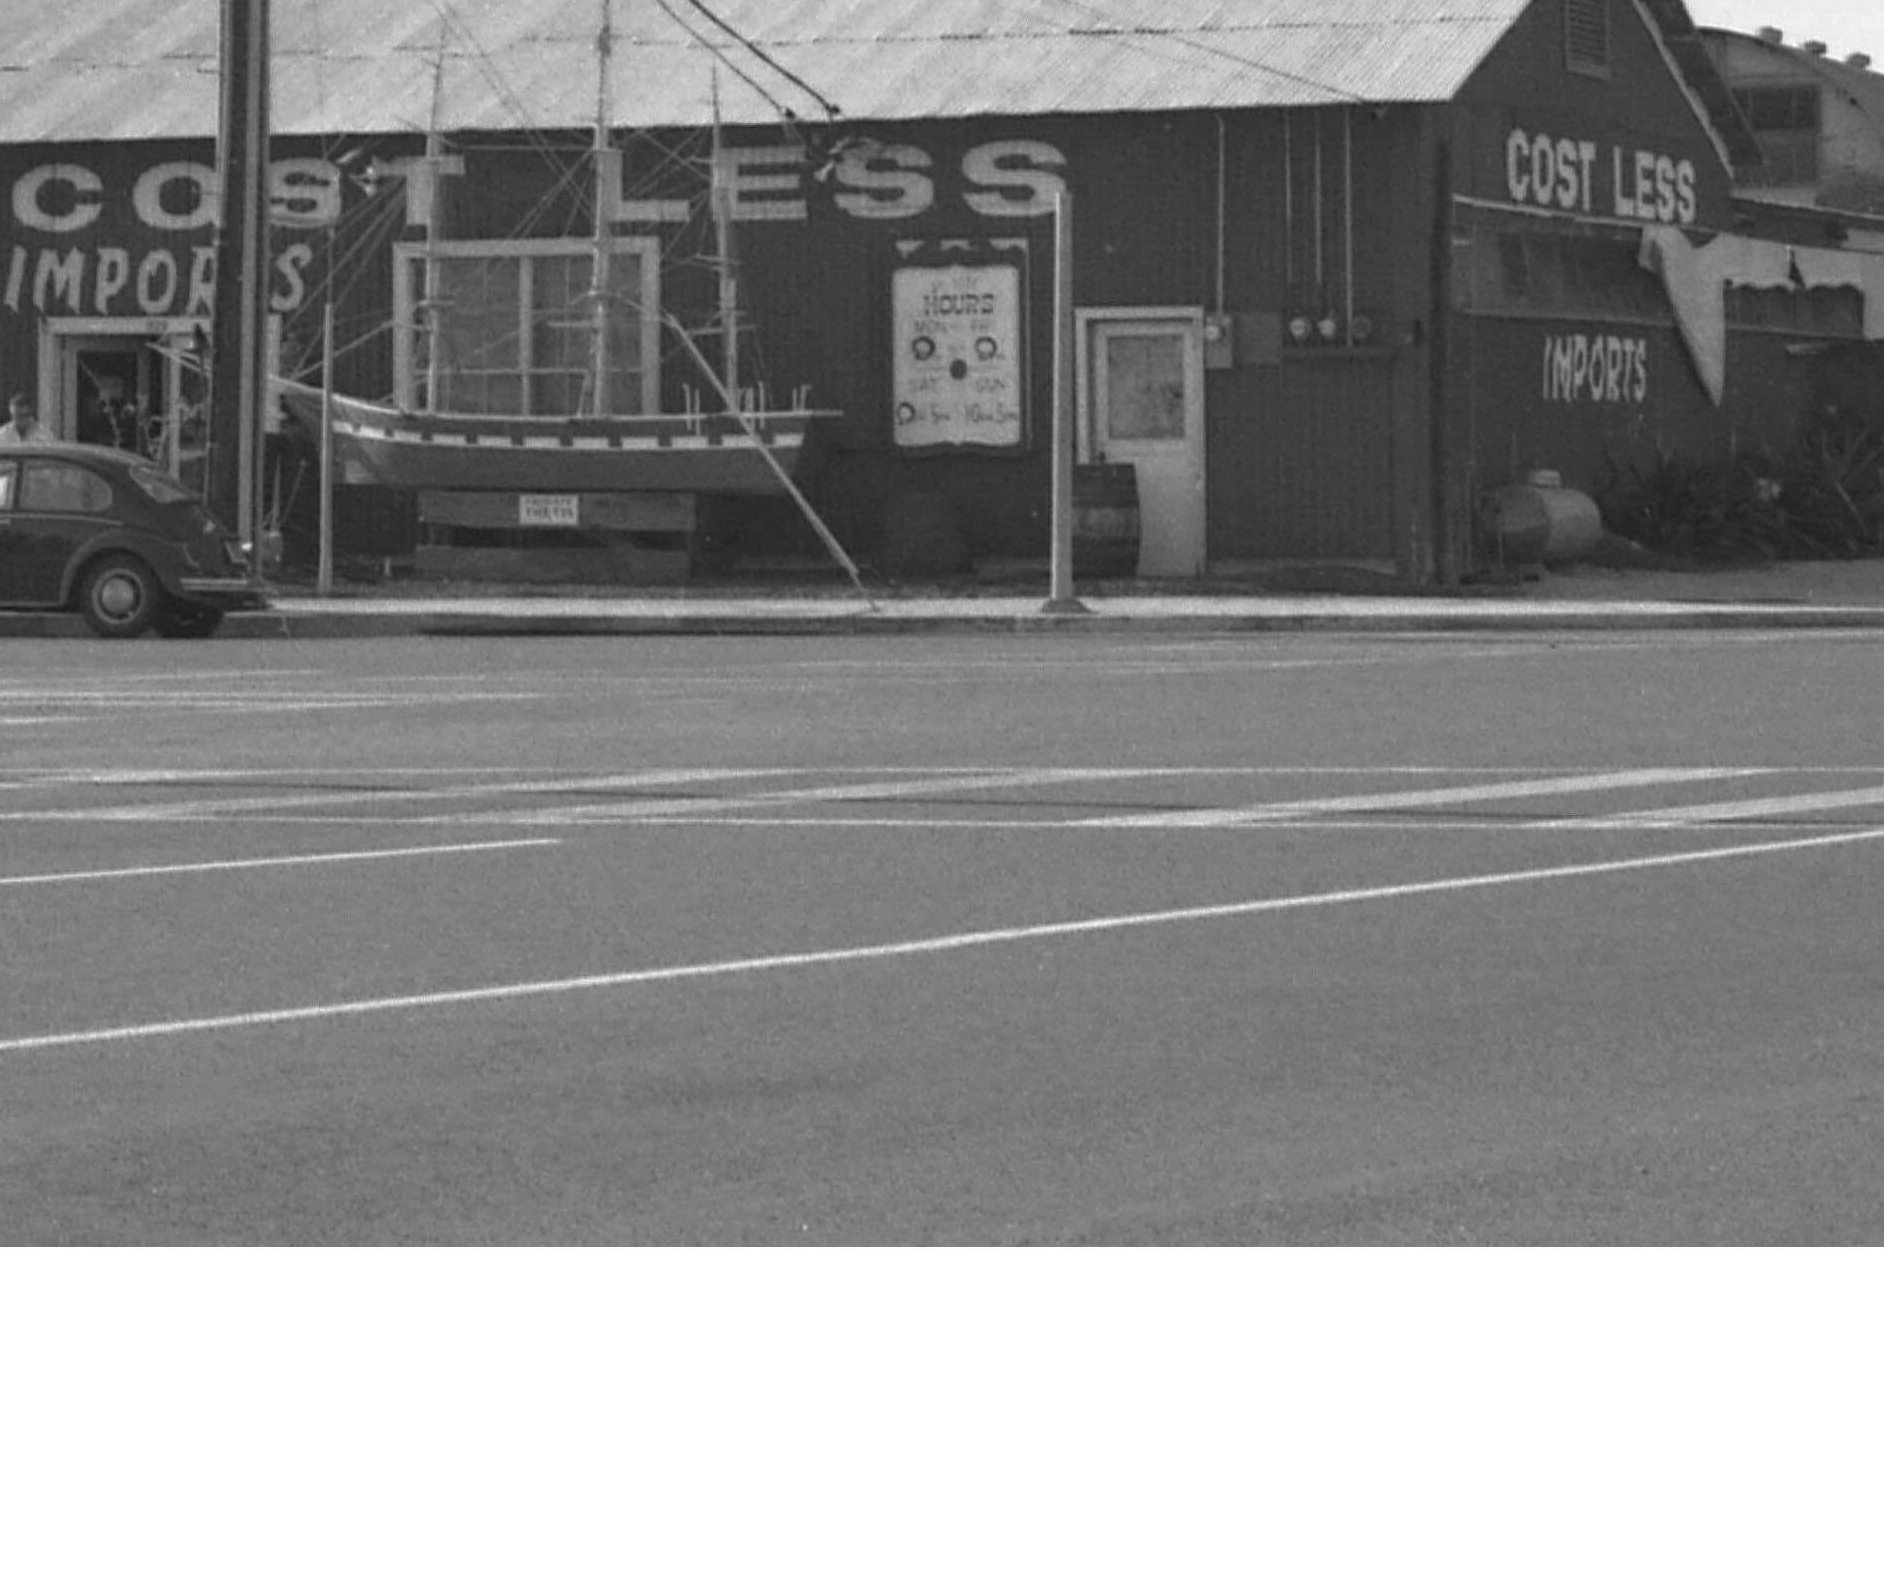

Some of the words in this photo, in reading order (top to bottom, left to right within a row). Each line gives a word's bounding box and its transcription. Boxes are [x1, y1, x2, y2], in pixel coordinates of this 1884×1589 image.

[12, 153, 465, 233] COST
[597, 139, 1067, 223] LESS
[1506, 127, 1596, 212] COST
[1614, 146, 1697, 224] LESS
[4, 243, 313, 315] IMPORS
[922, 292, 995, 316] HOURS
[1542, 332, 1648, 403] IMPORTS
